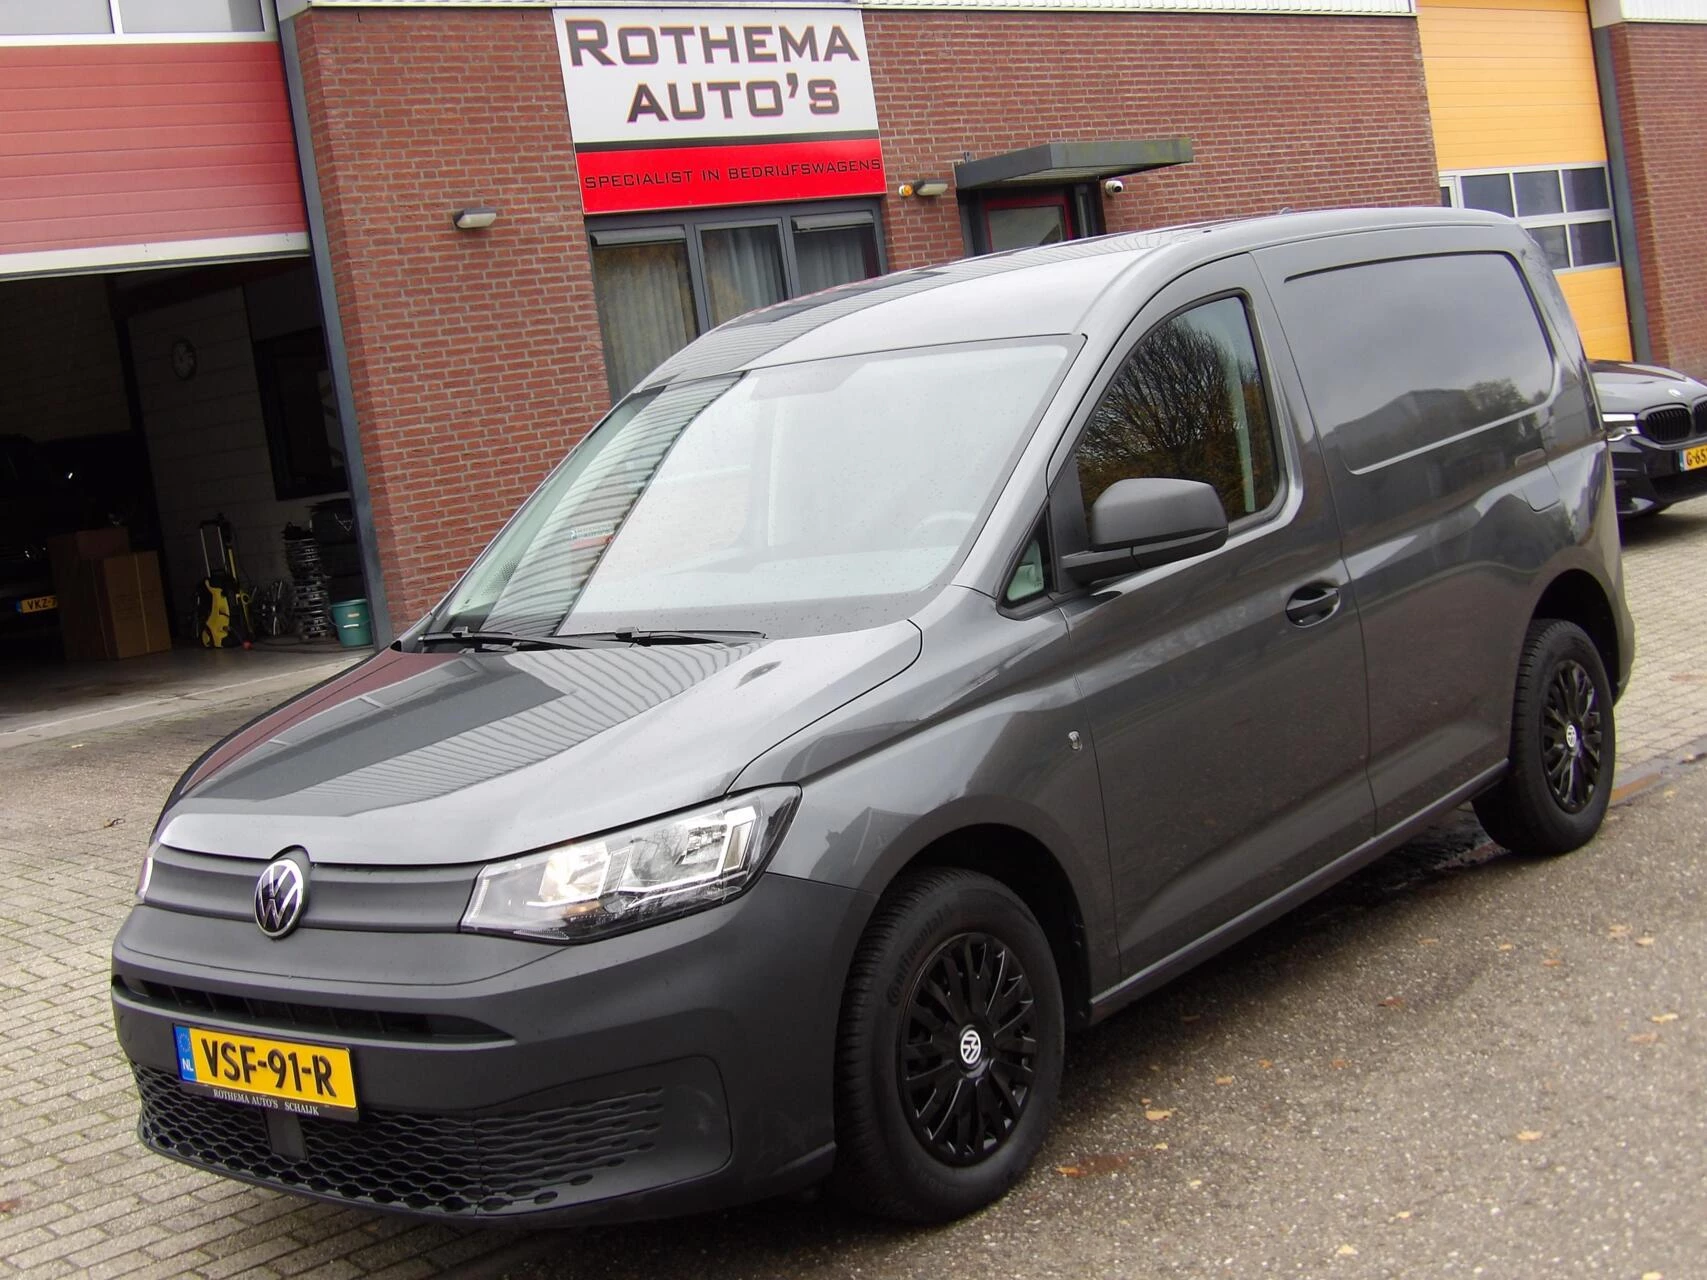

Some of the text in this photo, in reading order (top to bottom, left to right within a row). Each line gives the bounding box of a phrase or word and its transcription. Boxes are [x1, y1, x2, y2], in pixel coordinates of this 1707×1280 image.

[565, 18, 860, 67] ROTHEMA
[626, 72, 840, 124] AUTO'S
[584, 158, 881, 189] SPECIALIST IN BEDRIJFSWAGENS
[182, 1058, 194, 1072] NL
[201, 1037, 338, 1098] VSF-91-R
[213, 1088, 250, 1104] ROTHEMA
[251, 1095, 279, 1109] AUTO'S
